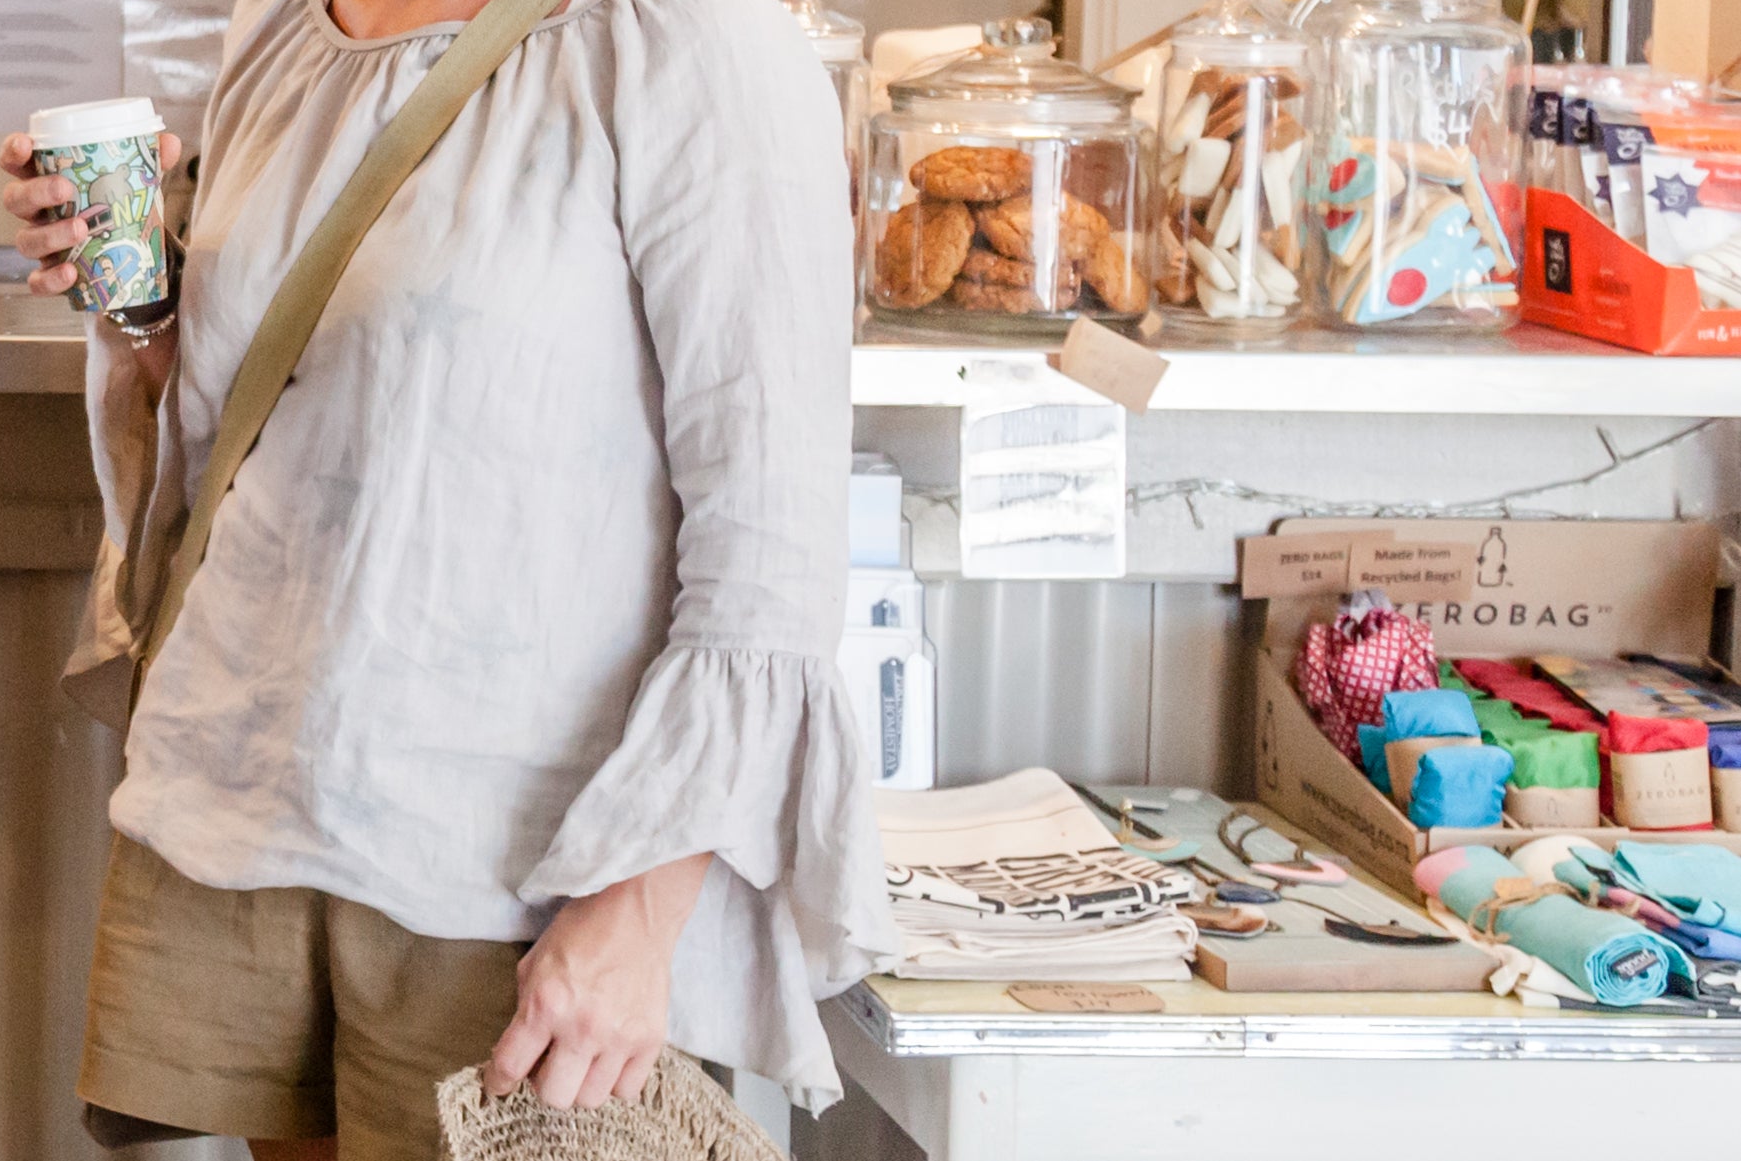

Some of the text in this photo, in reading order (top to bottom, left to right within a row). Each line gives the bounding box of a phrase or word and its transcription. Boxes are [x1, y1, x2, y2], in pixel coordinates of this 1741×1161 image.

[111, 189, 148, 228] NZ
[1375, 546, 1451, 561] Made from
[1361, 570, 1420, 585] Recycled
[1394, 603, 1590, 628] EROBAG
[883, 696, 897, 773] HOMESTAY
